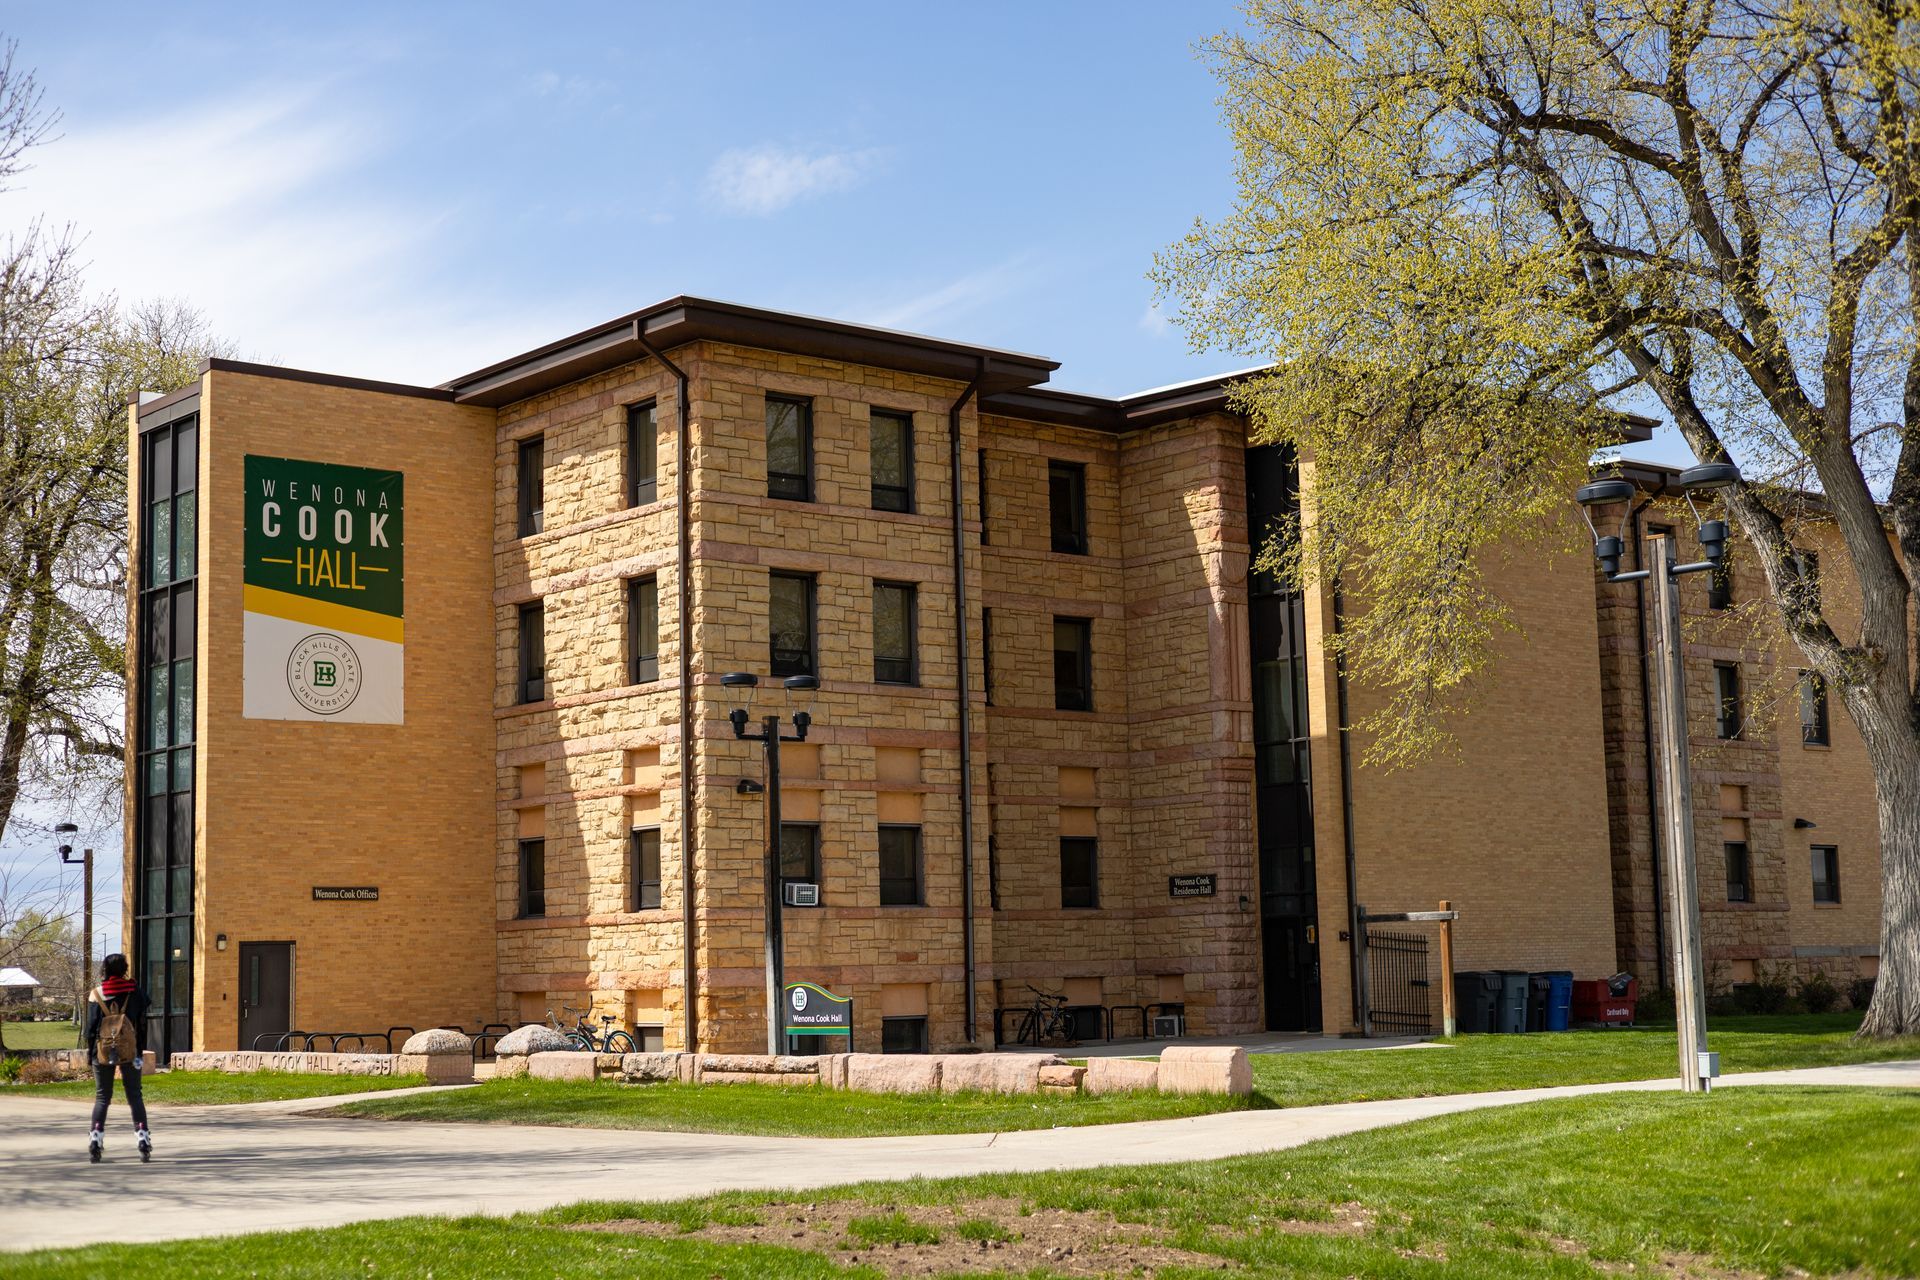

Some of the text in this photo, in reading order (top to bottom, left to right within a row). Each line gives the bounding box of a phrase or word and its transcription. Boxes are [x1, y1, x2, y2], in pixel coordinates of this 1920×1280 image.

[262, 478, 388, 509] WENONA
[262, 501, 389, 548] COOK
[296, 547, 366, 590] HALL
[295, 641, 355, 683] BLACK HILLS STATE
[299, 686, 350, 707] UNIVERSITY
[1196, 876, 1210, 885] Cook
[315, 889, 378, 899] Wenona Cook Offices
[1173, 886, 1212, 895] Residence Hall
[793, 1014, 842, 1023] Wenona Cook Hall
[230, 1055, 264, 1070] WENONA
[271, 1054, 302, 1070] COOK
[306, 1055, 334, 1072] HALL
